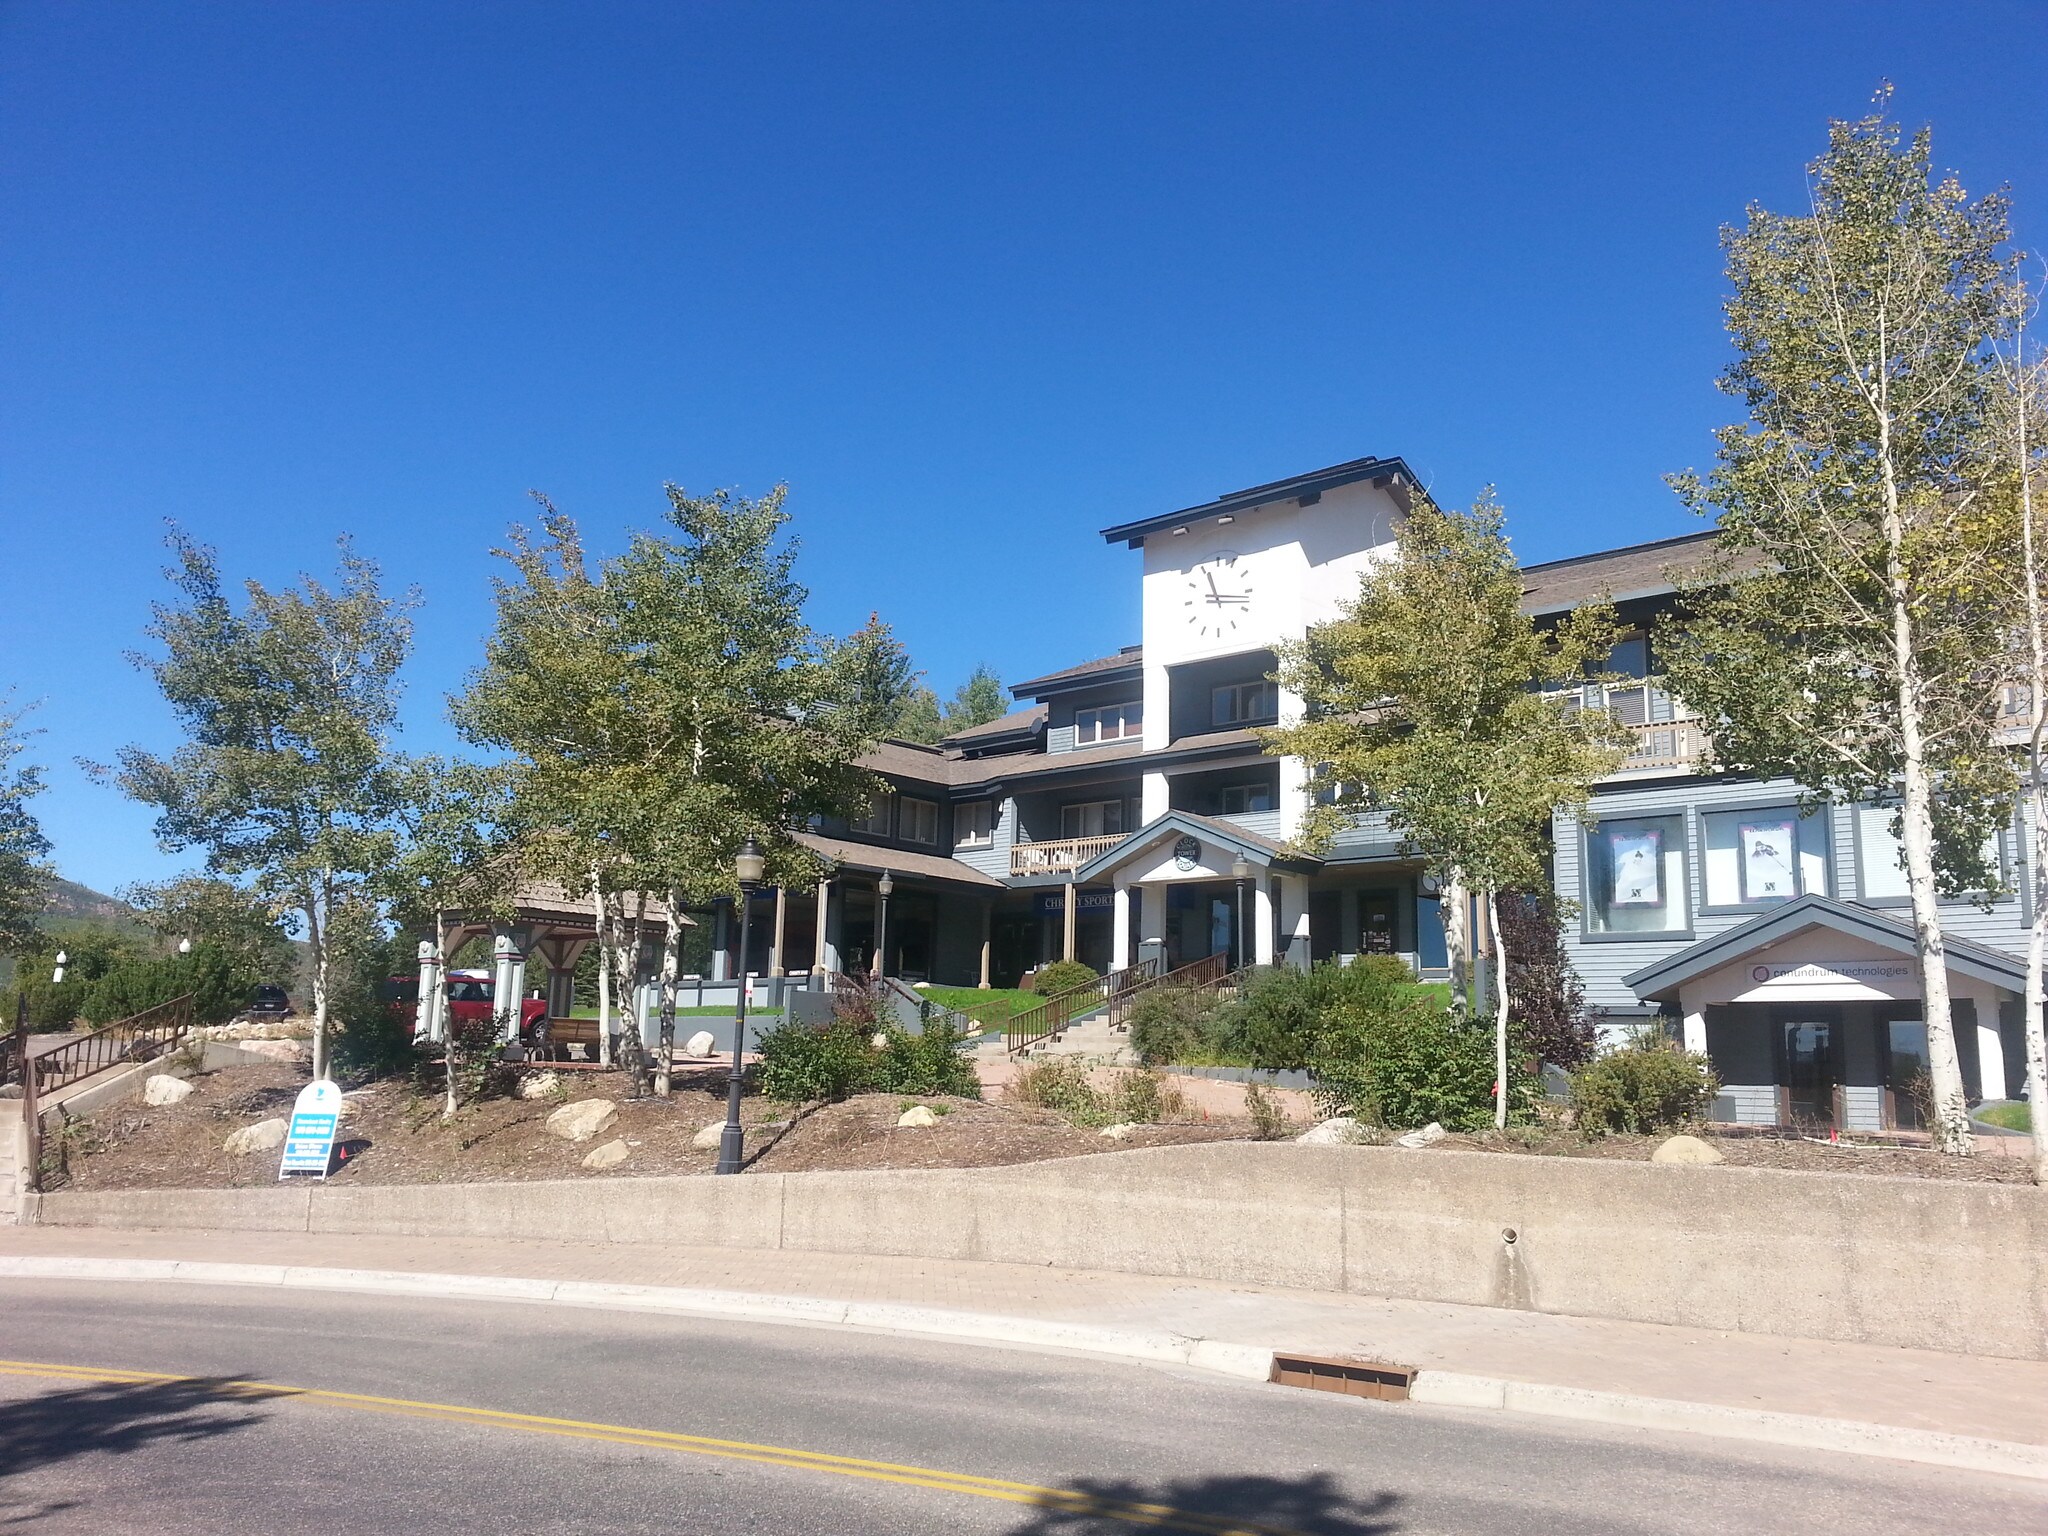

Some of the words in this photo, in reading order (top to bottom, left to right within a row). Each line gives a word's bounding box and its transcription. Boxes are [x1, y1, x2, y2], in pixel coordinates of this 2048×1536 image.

[1045, 897, 1082, 908] CHRY
[1084, 895, 1114, 906] SPORT
[1773, 967, 1838, 978] conundrum
[1841, 965, 1908, 978] technologies
